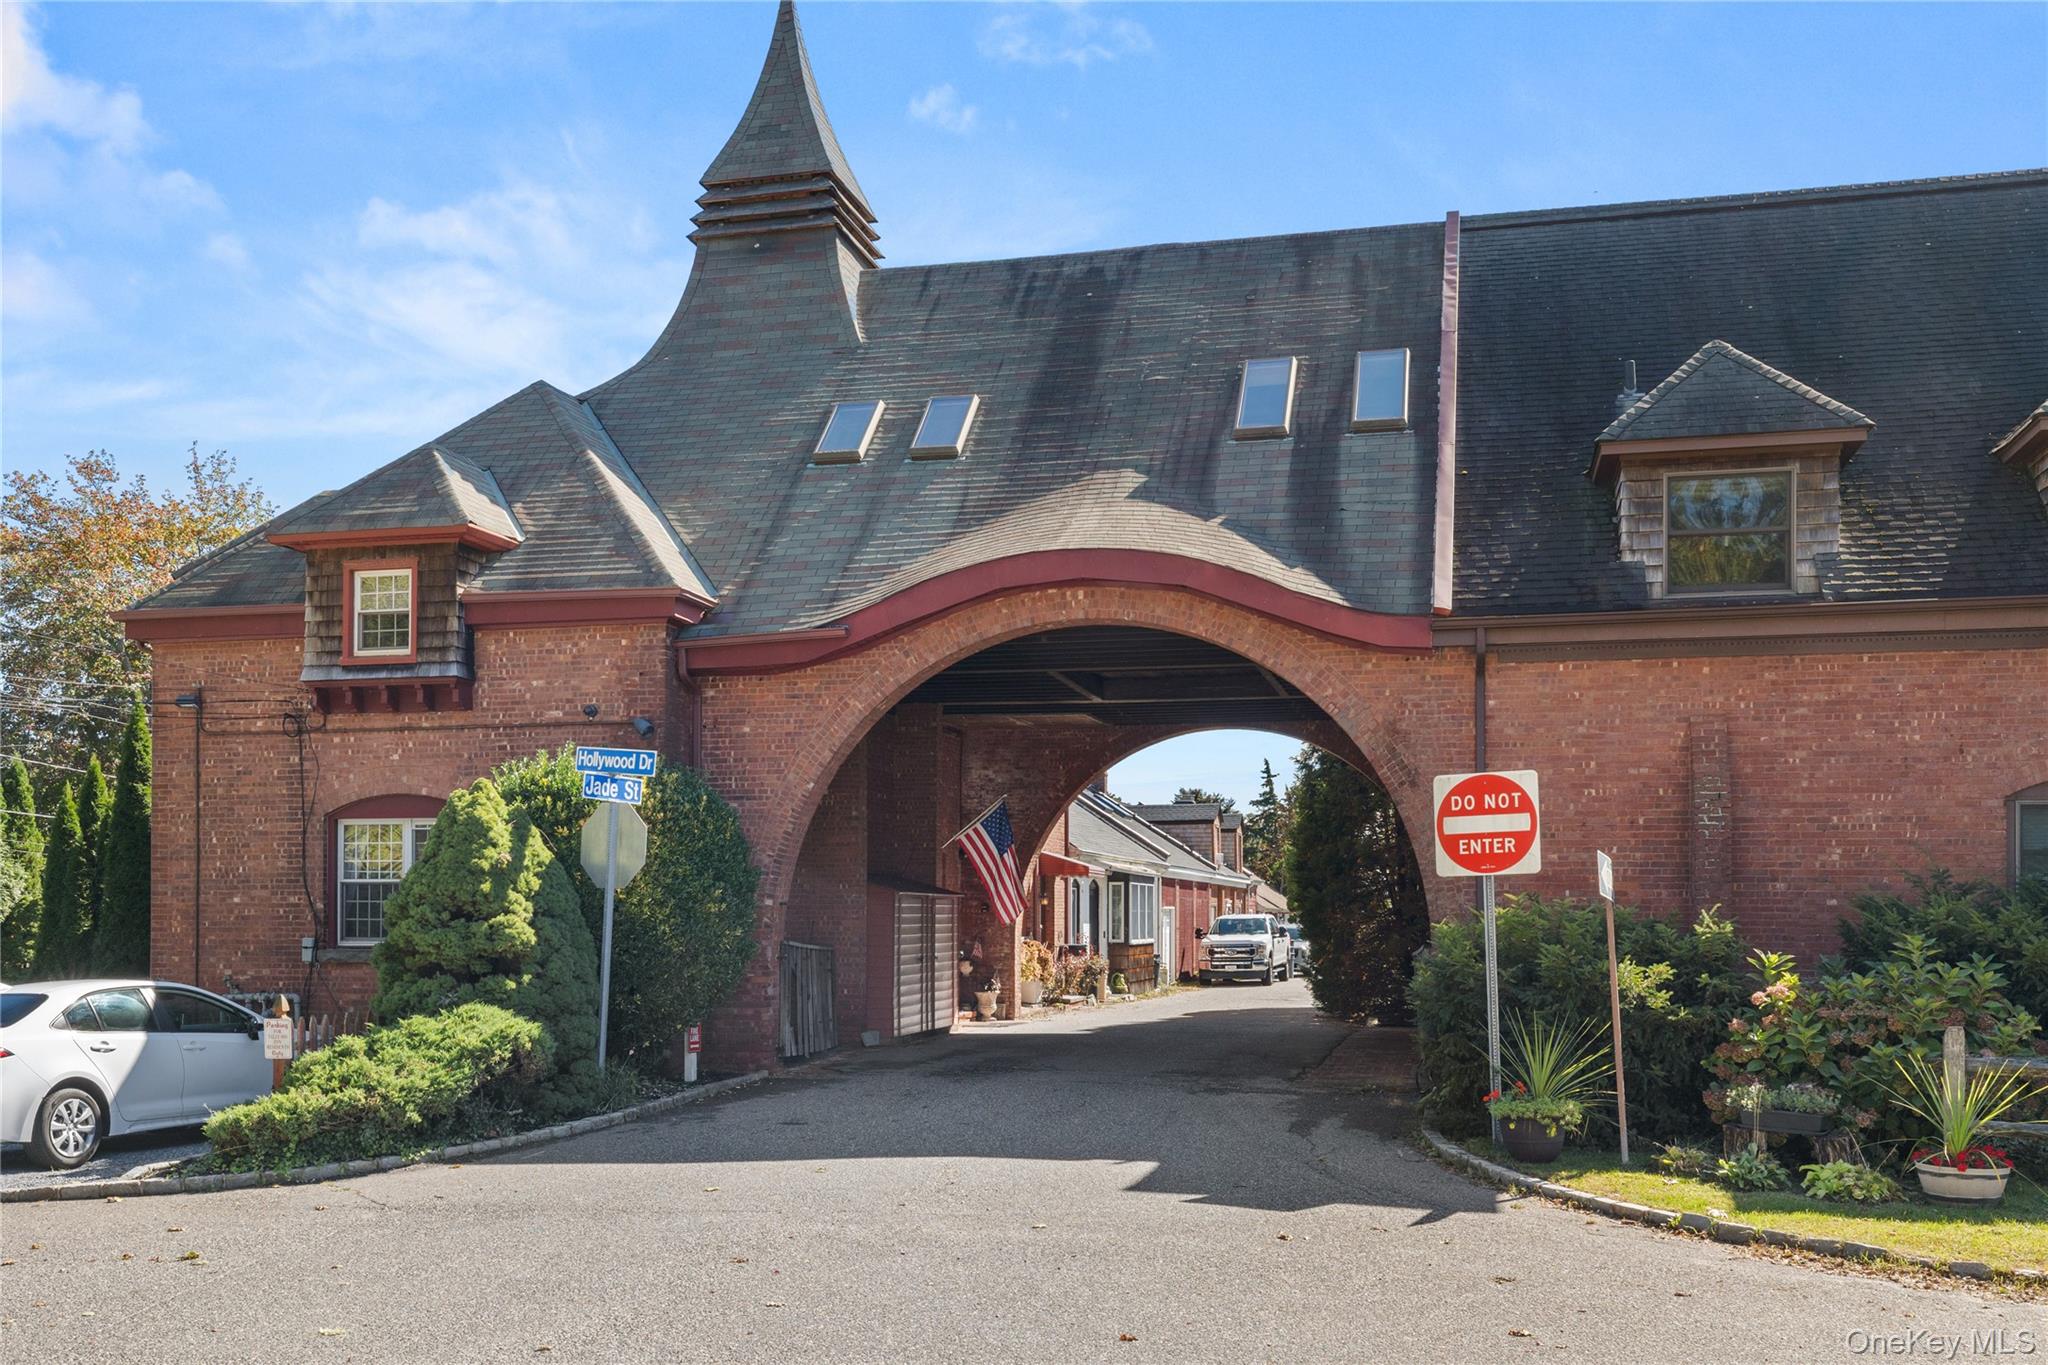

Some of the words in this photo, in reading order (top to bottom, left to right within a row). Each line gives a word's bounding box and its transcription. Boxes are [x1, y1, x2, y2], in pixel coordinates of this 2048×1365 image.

[578, 750, 636, 770] Hollywood
[638, 753, 653, 770] Dr
[585, 775, 619, 797] Jade
[624, 781, 639, 800] St
[1450, 795, 1475, 811] DO
[1484, 792, 1522, 809] NOT
[1459, 837, 1516, 855] ENTER
[266, 1021, 289, 1030] Parking
